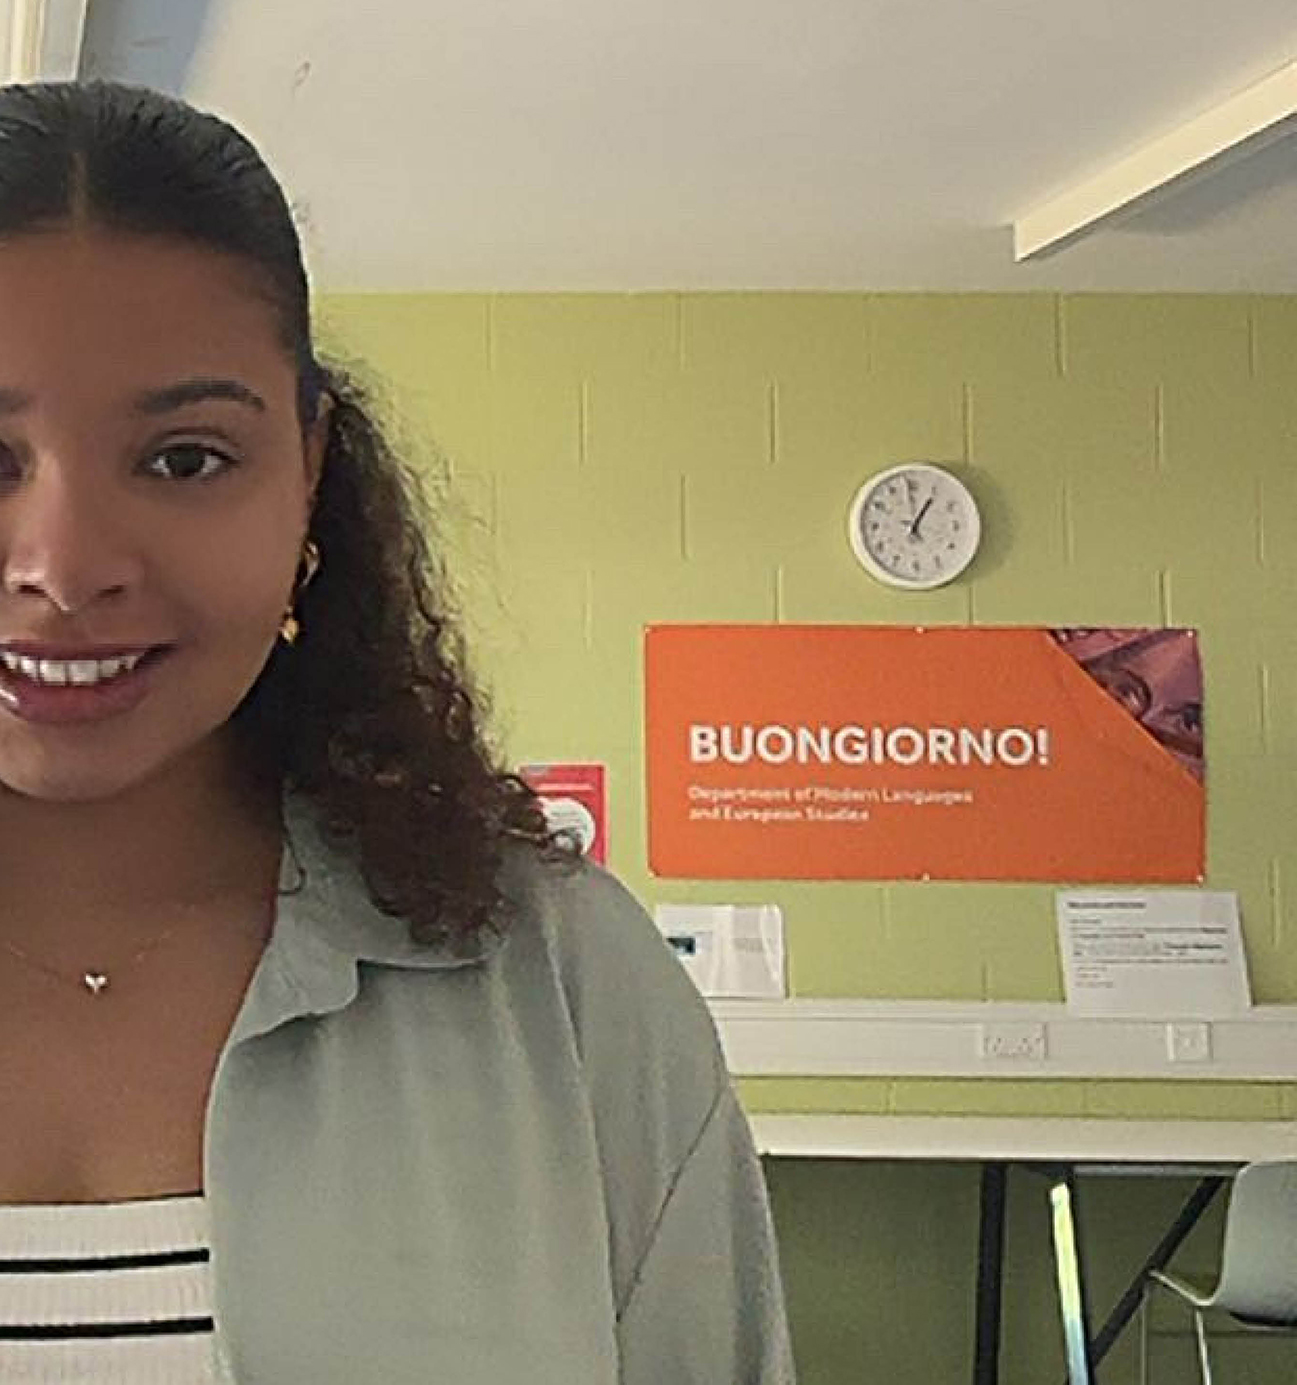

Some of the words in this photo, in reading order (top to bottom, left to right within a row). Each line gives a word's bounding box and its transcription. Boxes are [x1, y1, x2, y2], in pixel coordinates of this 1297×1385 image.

[689, 724, 1050, 766] BUONGIORNO!
[687, 786, 790, 803] Department
[813, 787, 880, 803] Modern
[882, 788, 975, 805] Languages
[723, 805, 801, 823] European
[804, 804, 870, 821] Studies
